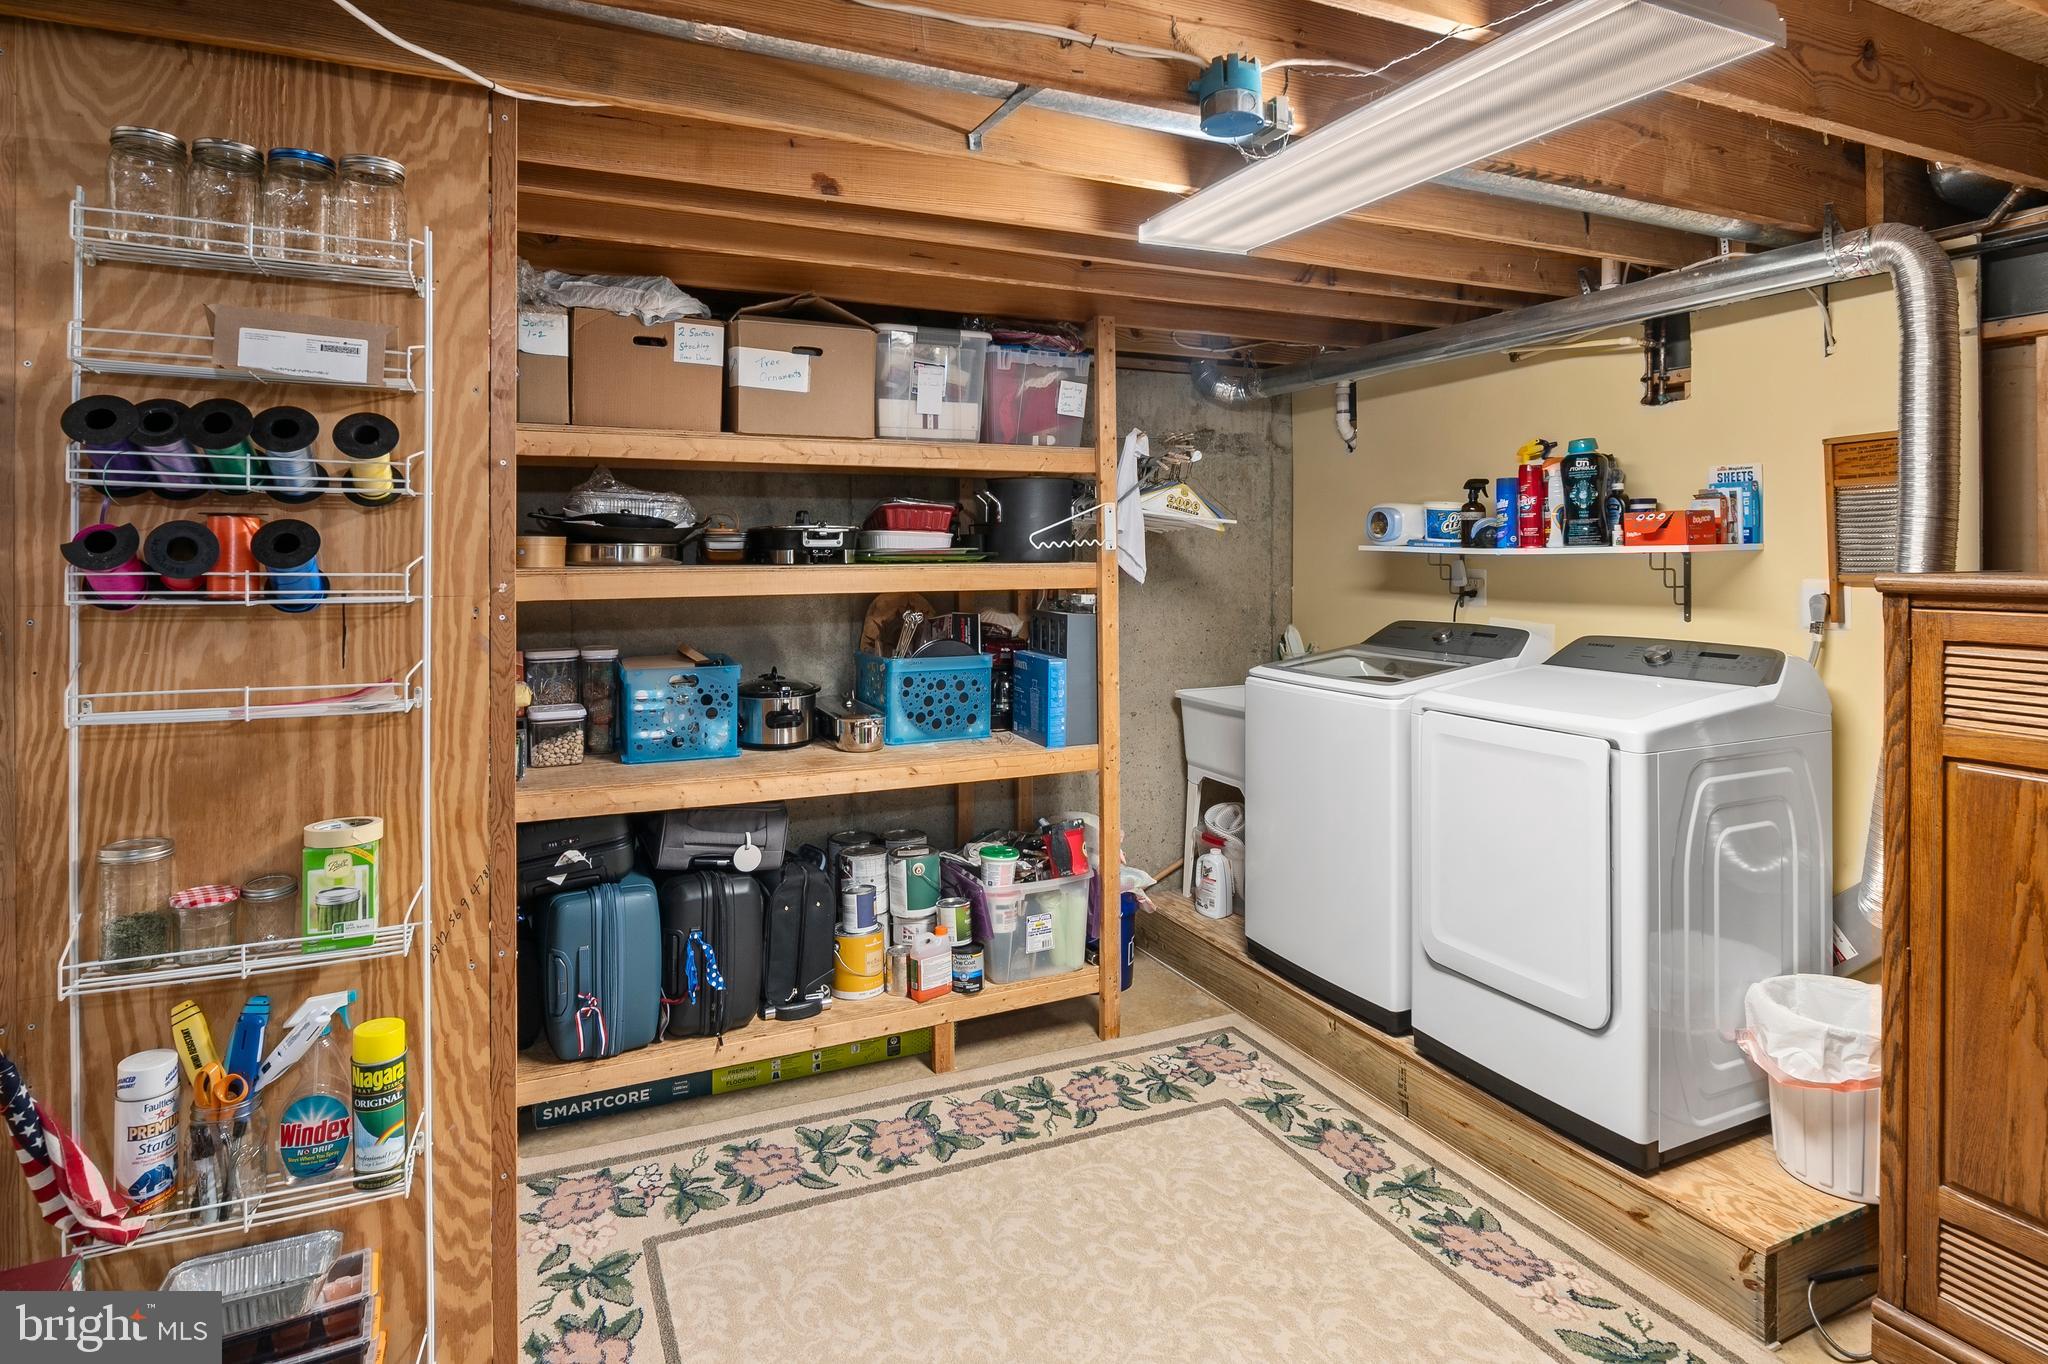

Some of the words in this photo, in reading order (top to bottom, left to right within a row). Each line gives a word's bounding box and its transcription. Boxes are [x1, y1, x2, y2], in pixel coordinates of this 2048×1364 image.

[527, 329, 547, 338] 1-2
[678, 326, 685, 337] 2
[1716, 470, 1754, 483] SHEETS
[328, 858, 349, 873] Ball
[352, 1061, 405, 1092] Niagara
[727, 1065, 755, 1075] PREMIUM
[726, 1075, 757, 1086] FLOORING
[354, 1091, 403, 1109] ORIGINAL
[543, 1088, 650, 1121] SMARTCORE
[280, 1116, 352, 1148] Windex
[137, 1133, 177, 1156] Starch
[312, 1143, 334, 1155] DRIP
